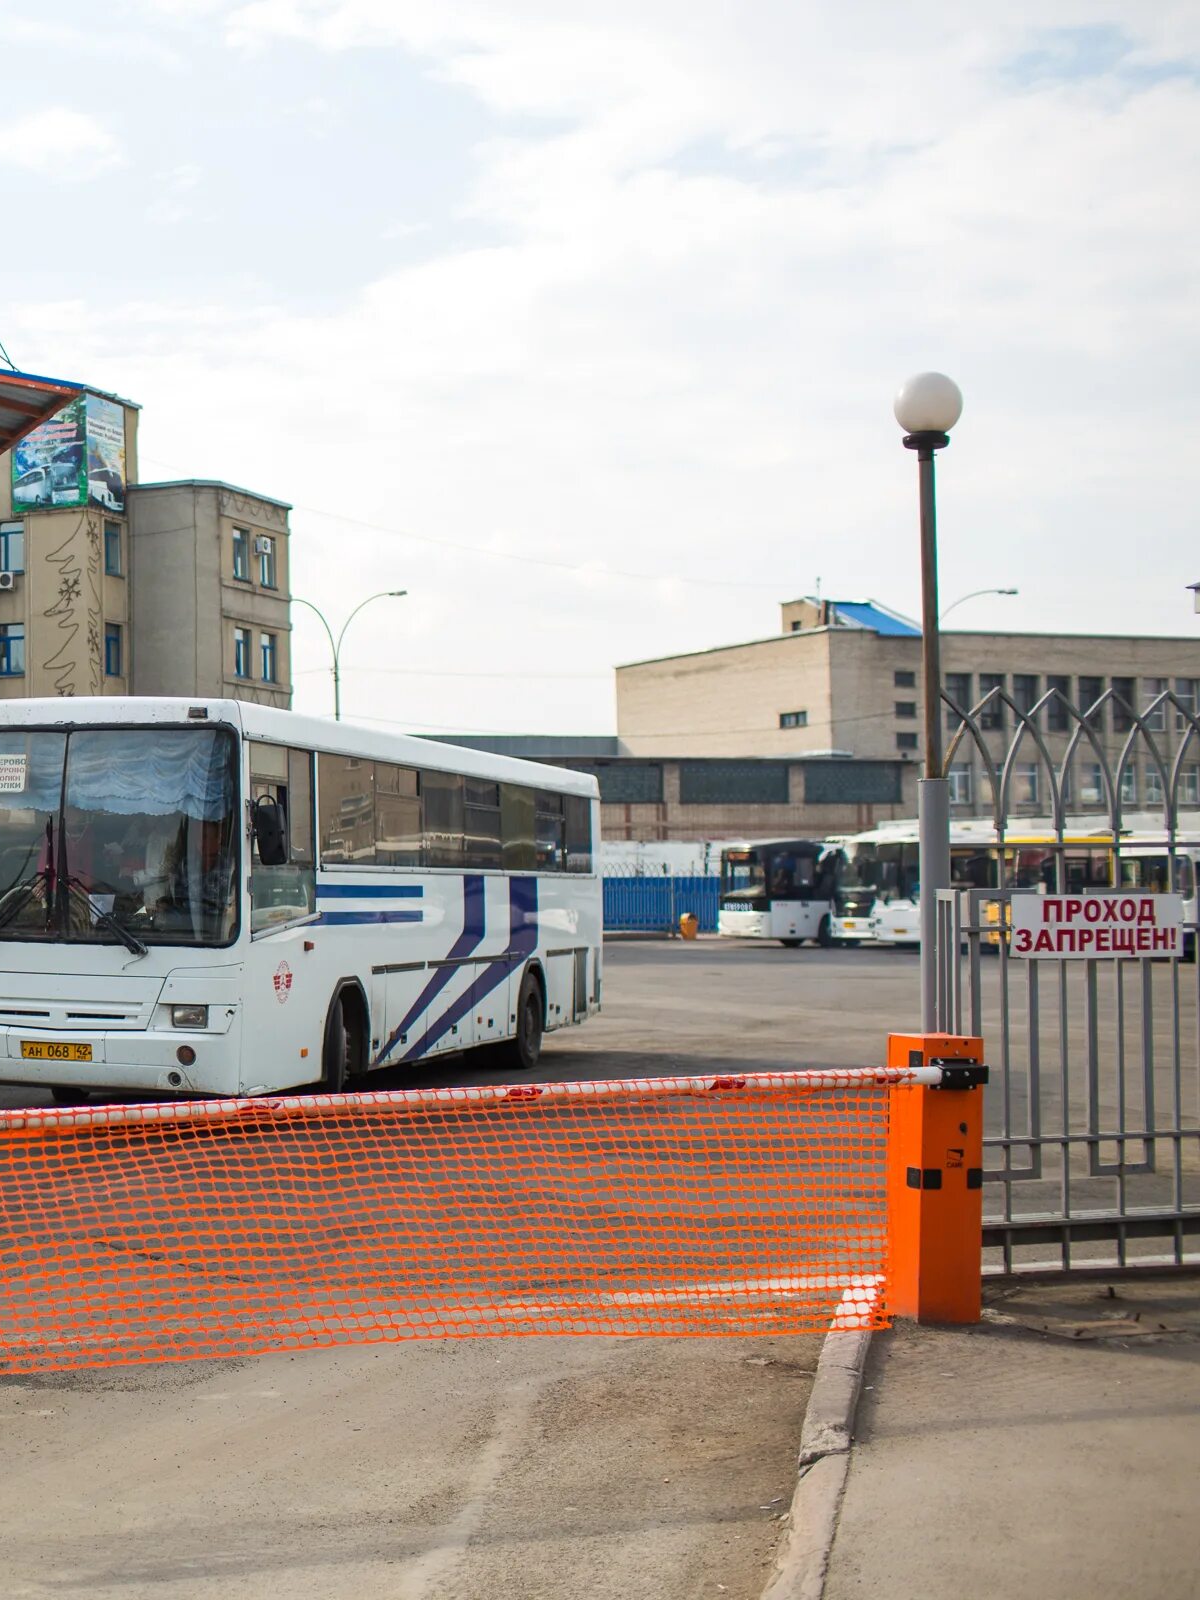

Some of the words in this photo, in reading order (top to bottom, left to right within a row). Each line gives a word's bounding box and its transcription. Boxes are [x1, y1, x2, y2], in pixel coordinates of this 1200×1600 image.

[1042, 898, 1156, 926] ПРОХОД
[1015, 927, 1177, 955] ЗАПРЕЩЕН!
[47, 1045, 69, 1058] 068
[76, 1046, 88, 1056] 42
